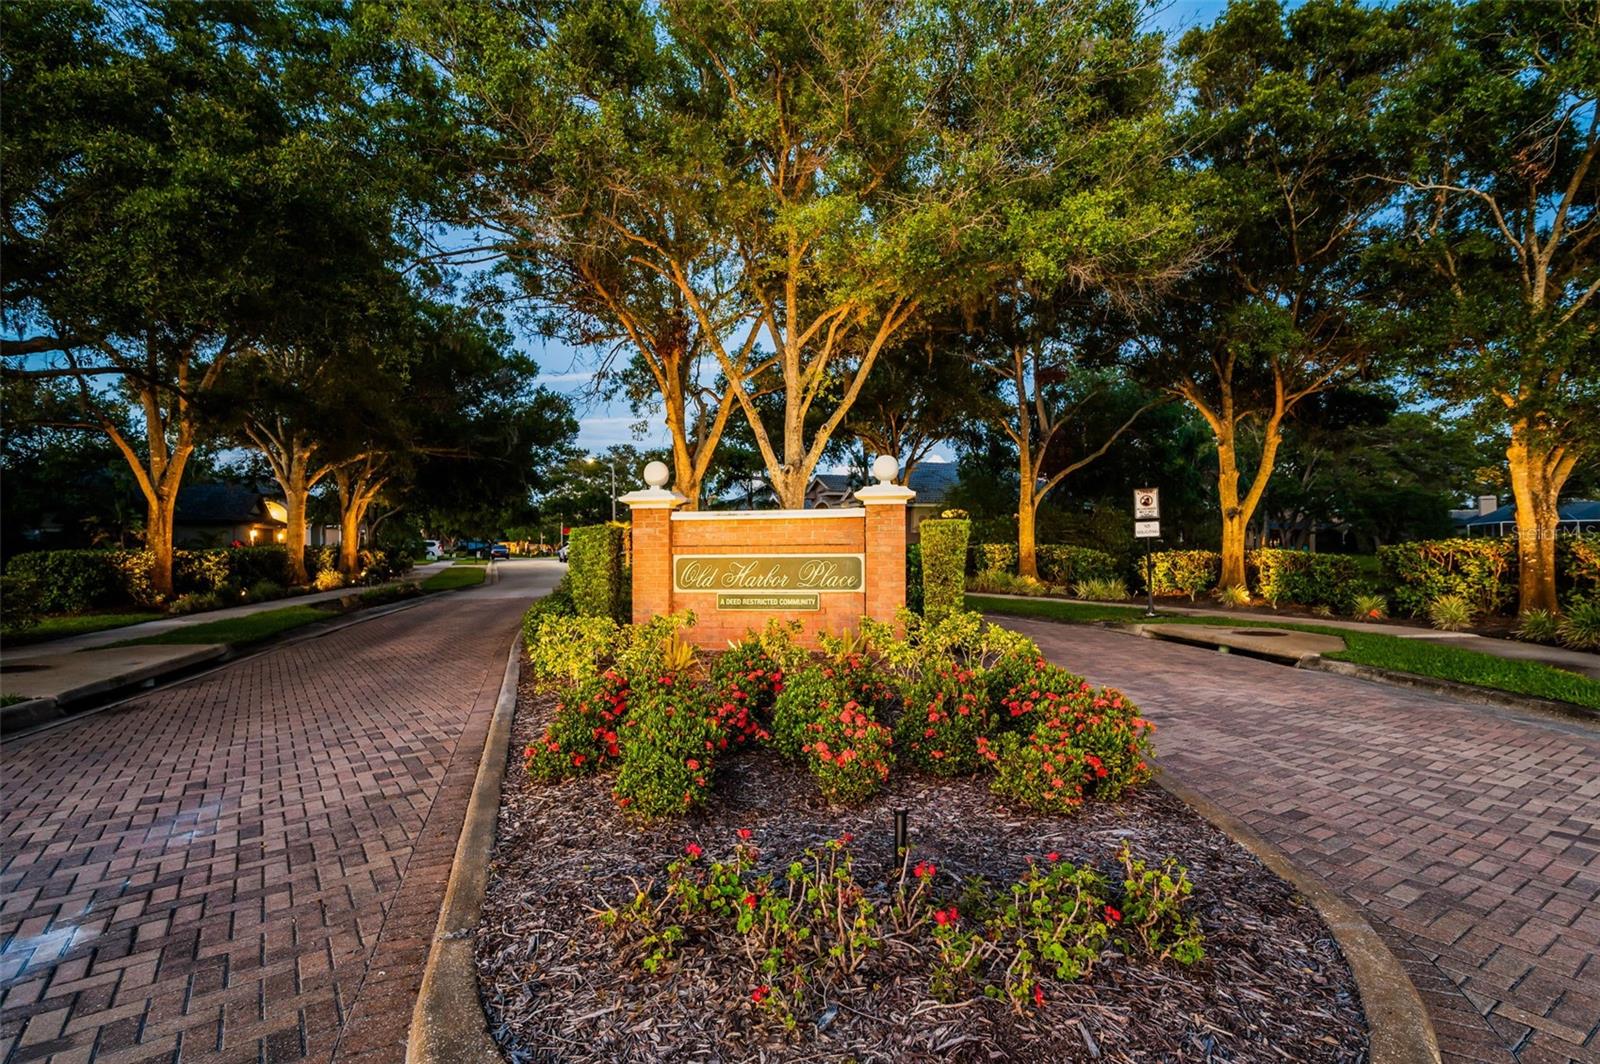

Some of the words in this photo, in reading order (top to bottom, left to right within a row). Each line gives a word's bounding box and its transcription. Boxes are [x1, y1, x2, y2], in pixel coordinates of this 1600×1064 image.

[680, 560, 718, 588] Old
[721, 560, 790, 588] Harbor
[797, 559, 857, 588] Place
